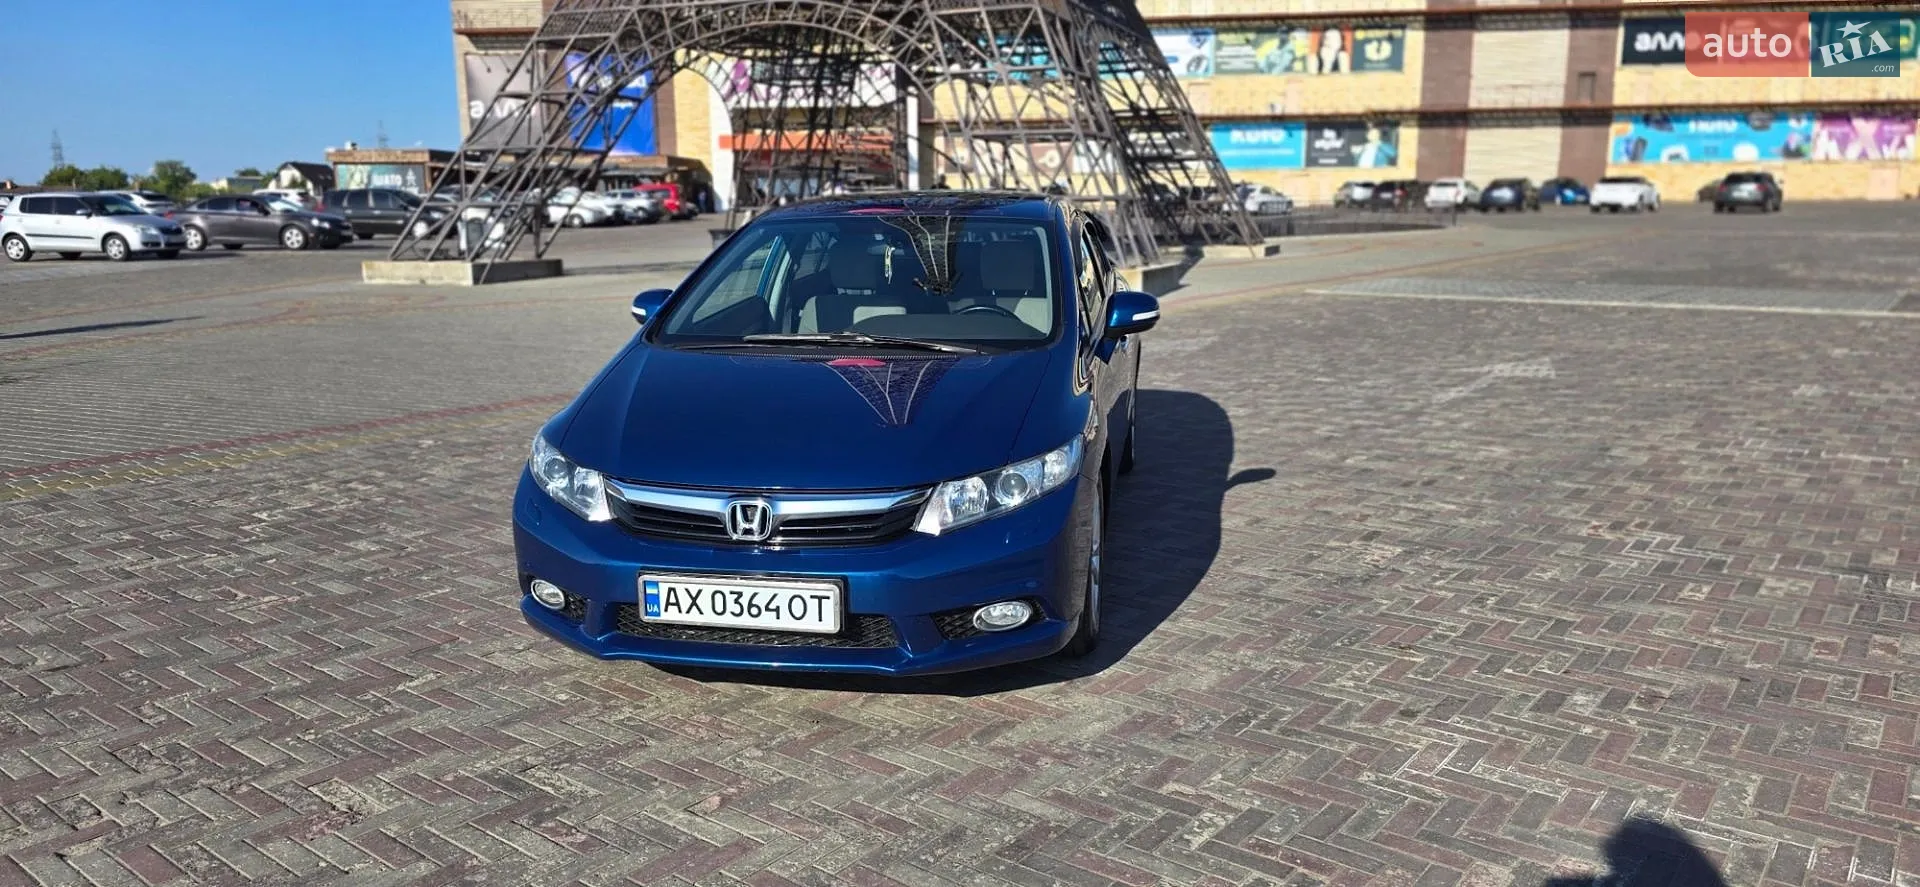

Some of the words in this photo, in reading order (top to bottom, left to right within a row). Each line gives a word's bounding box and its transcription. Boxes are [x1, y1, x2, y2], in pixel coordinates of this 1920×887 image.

[647, 603, 659, 613] UA
[664, 586, 704, 615] AX
[711, 590, 781, 620] 0364
[788, 594, 830, 622] OT
